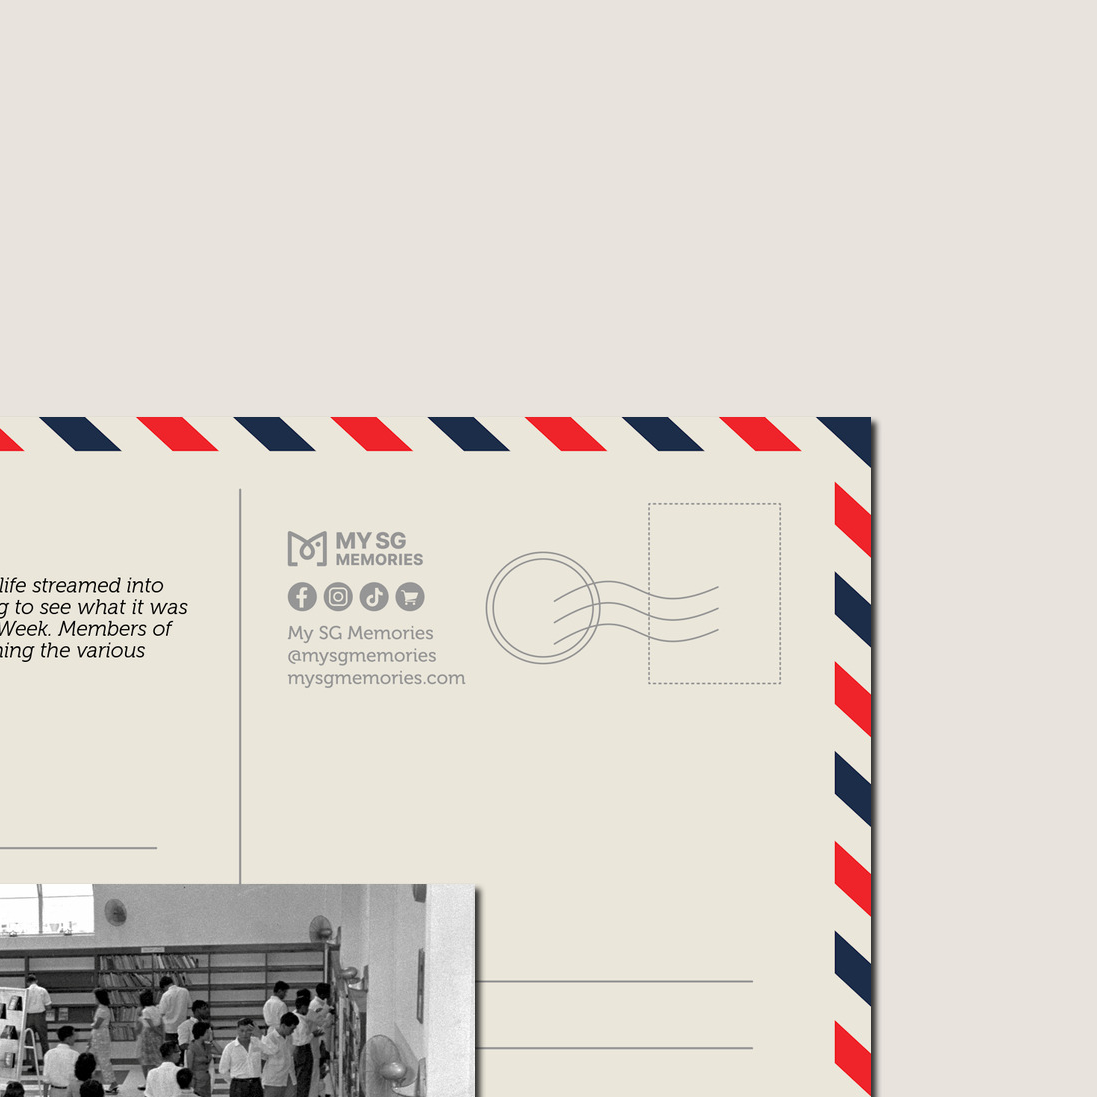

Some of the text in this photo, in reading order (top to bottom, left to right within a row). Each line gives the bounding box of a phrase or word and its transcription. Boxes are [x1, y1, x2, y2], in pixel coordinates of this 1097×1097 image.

[337, 532, 406, 549] MY SG
[337, 554, 423, 565] MEMORIES
[0, 577, 26, 593] life
[32, 577, 121, 593] streamed
[127, 577, 163, 593] into
[16, 600, 33, 614] to
[40, 603, 71, 614] see
[78, 599, 126, 614] what
[133, 599, 144, 614] it
[150, 603, 187, 614] was
[58, 621, 146, 636] Members
[153, 621, 173, 636] of
[288, 626, 433, 643] My SG Memories
[41, 642, 70, 658] the
[77, 642, 145, 658] various
[288, 648, 436, 666] @mysgmemories
[288, 671, 465, 688] mysgmemories.com
